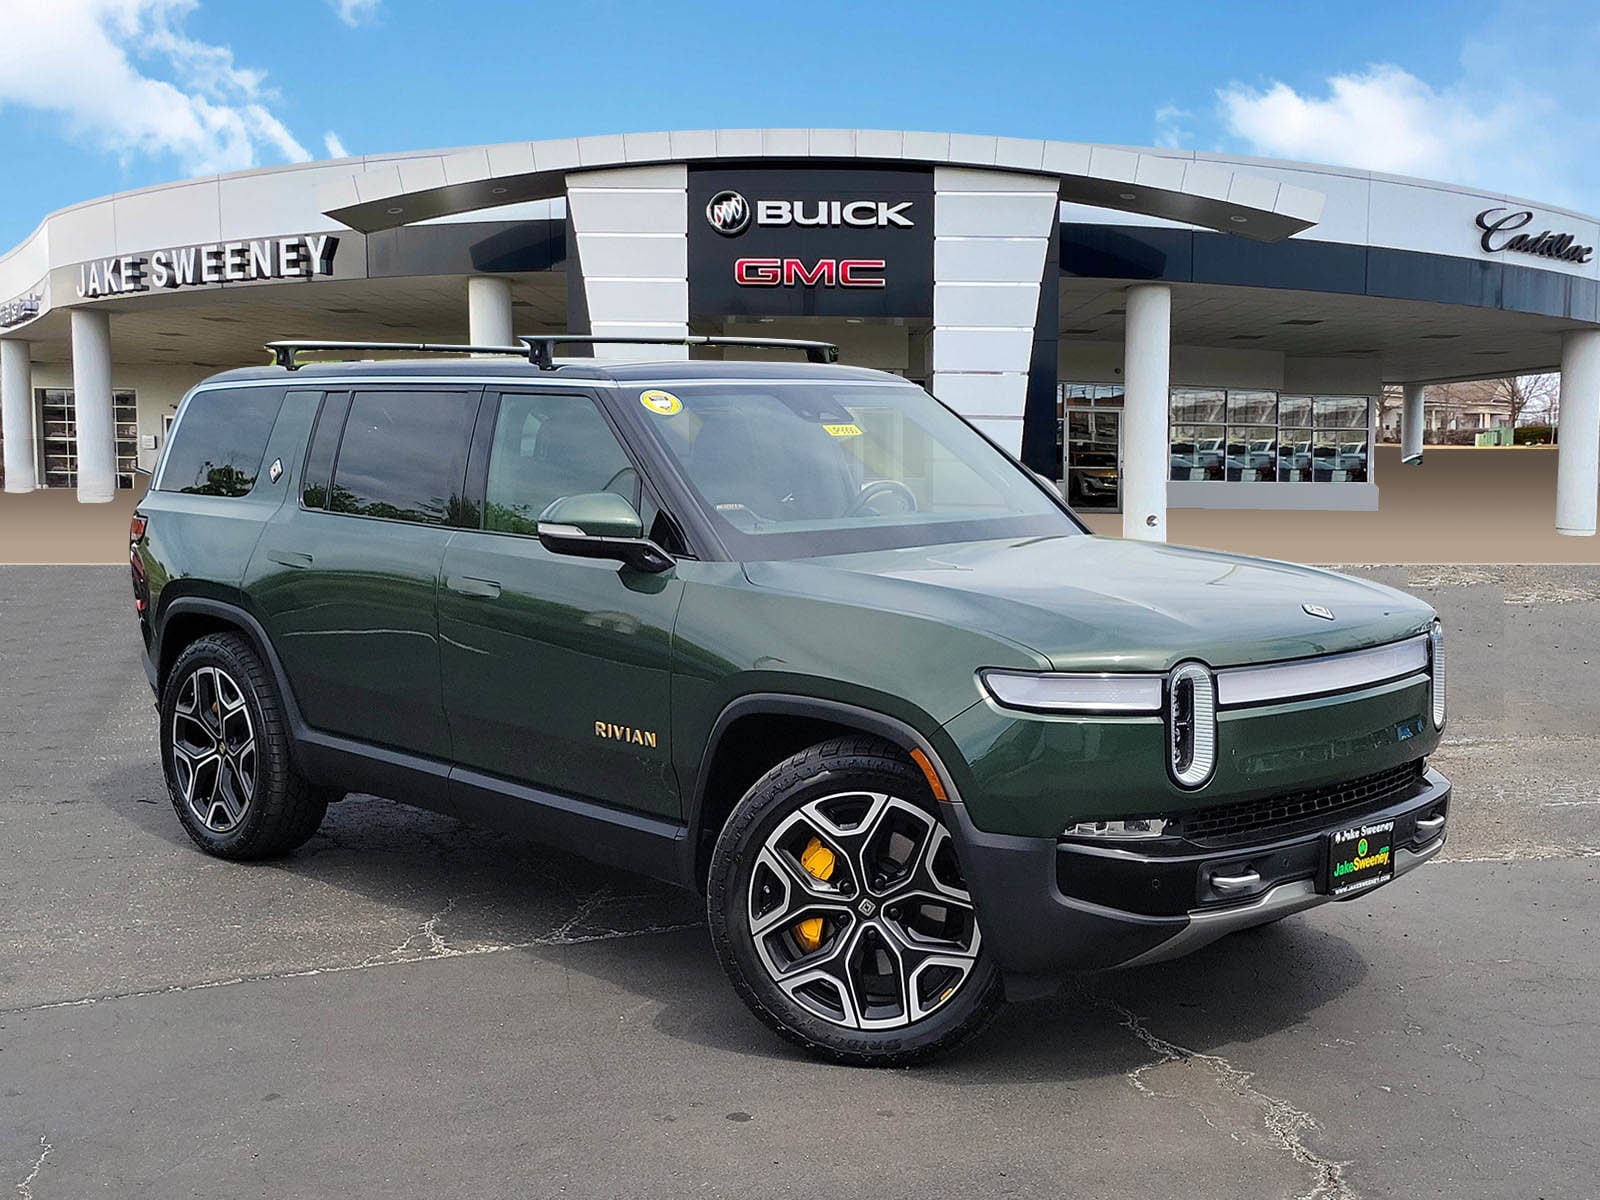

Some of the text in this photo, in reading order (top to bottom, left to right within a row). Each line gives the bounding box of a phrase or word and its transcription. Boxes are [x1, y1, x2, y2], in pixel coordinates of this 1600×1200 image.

[757, 200, 914, 226] BUICK
[1475, 208, 1593, 263] Cadillac
[76, 235, 334, 298] JAKE SWEENEY
[735, 258, 886, 287] GMC
[595, 721, 657, 748] RIVIAN
[1341, 821, 1394, 842] Jake Sweeney
